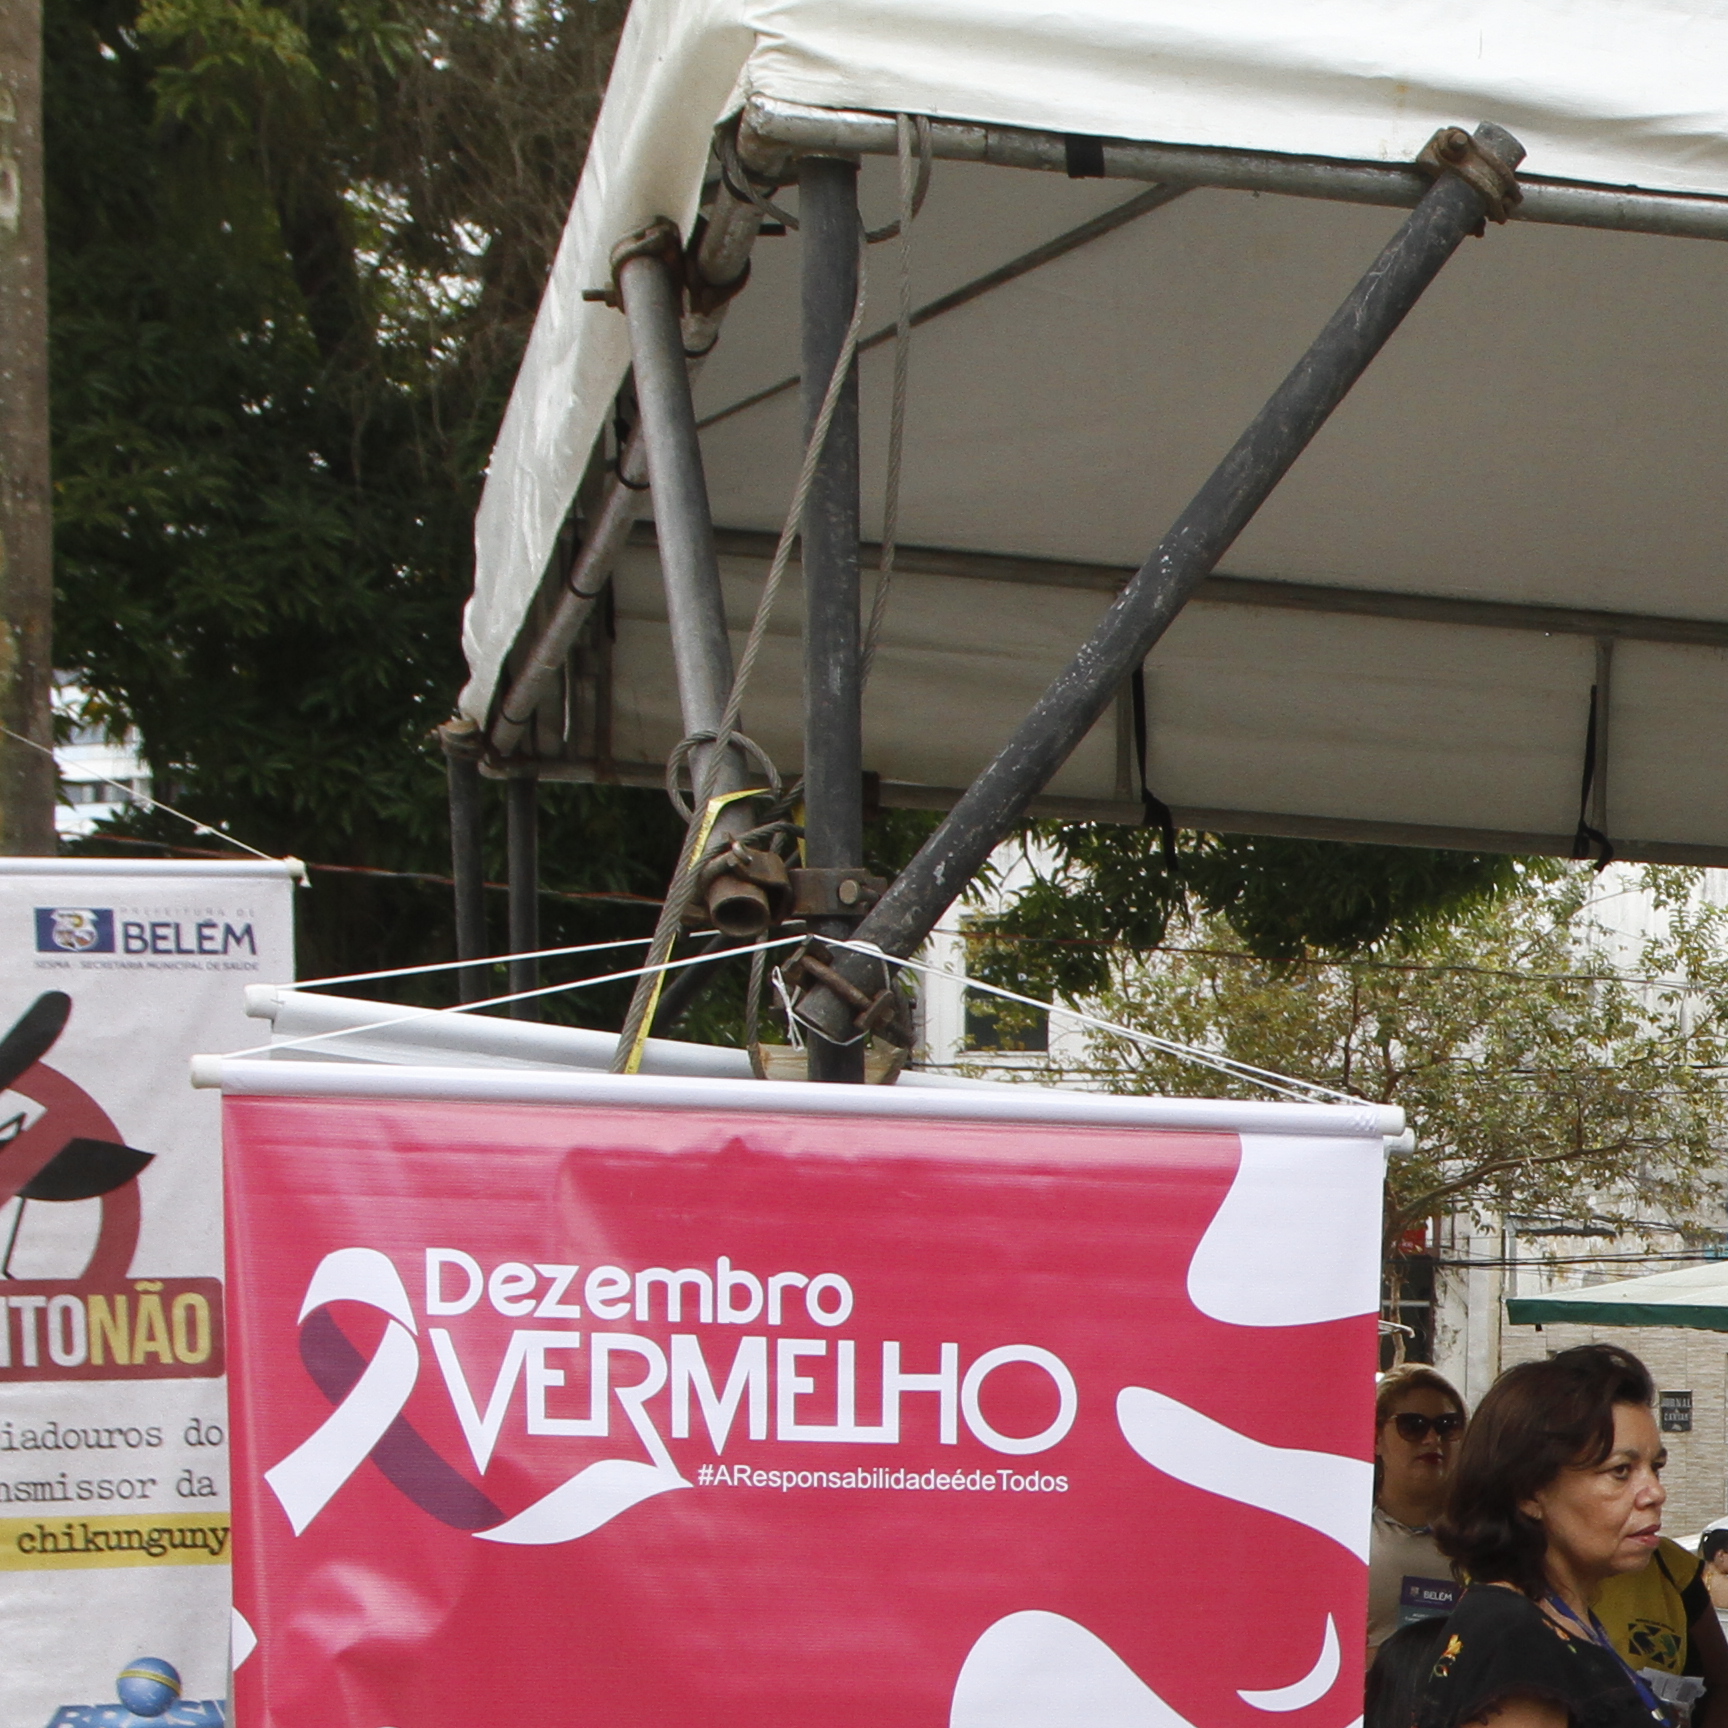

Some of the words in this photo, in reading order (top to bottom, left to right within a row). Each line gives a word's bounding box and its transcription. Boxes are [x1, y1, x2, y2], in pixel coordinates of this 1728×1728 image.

[122, 918, 257, 956] BELÉM
[425, 1248, 854, 1328] Dezembro
[427, 1326, 1078, 1488] VERMELHO
[184, 1417, 223, 1447] do
[176, 1469, 218, 1498] da
[698, 1463, 1069, 1493] #AResponsabilidadeédeTodos
